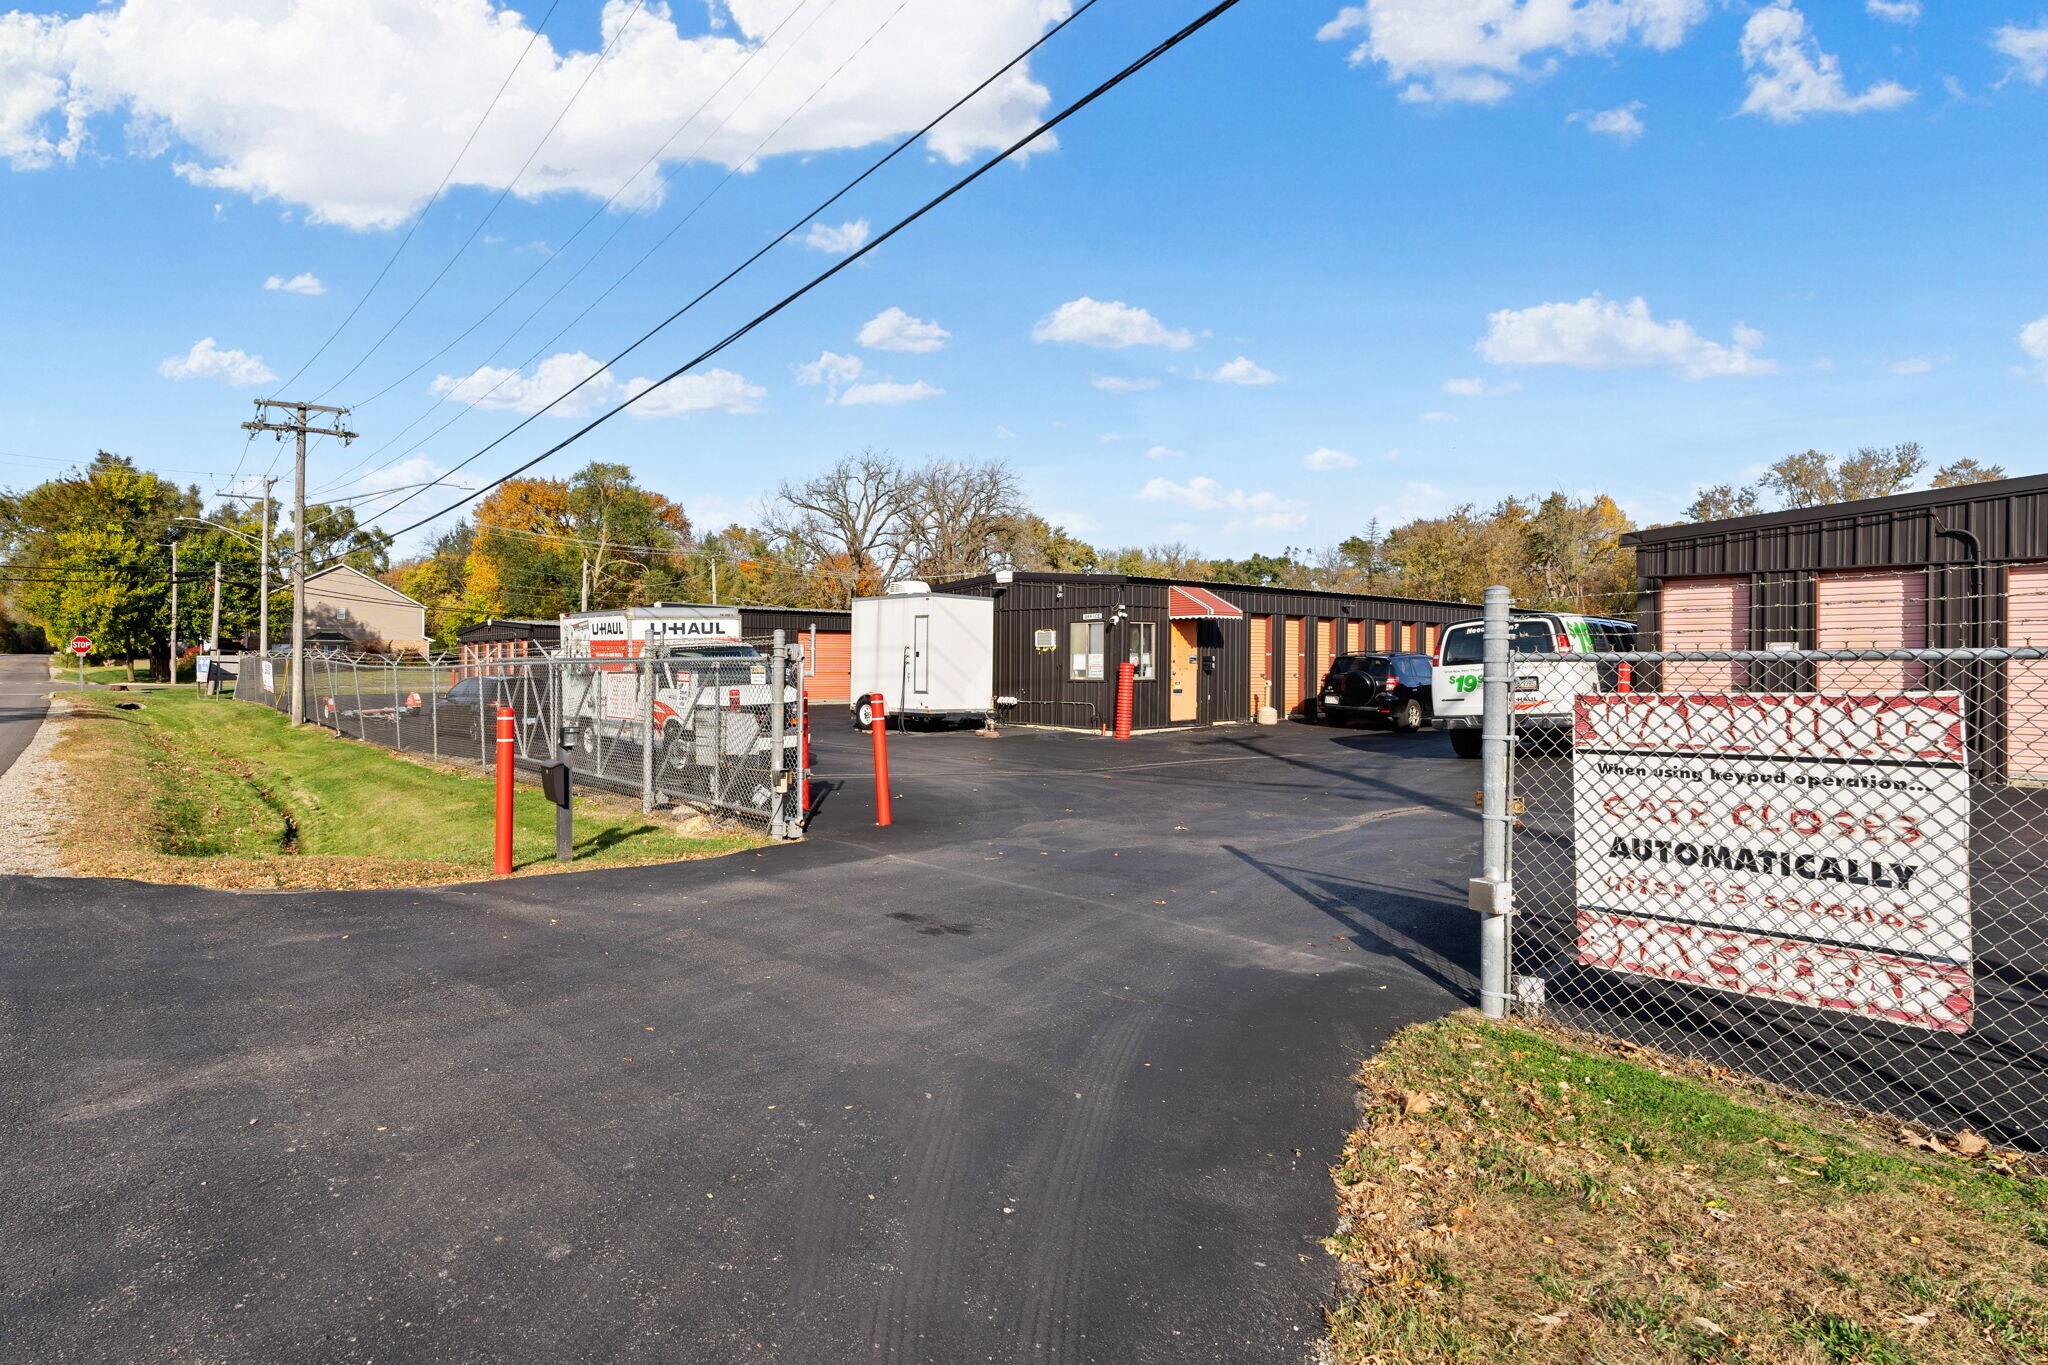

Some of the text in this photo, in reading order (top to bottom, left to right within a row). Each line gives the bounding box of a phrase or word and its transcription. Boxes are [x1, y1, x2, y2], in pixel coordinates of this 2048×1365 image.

[592, 622, 624, 635] U-HAUL
[650, 622, 726, 635] U-HAUL
[1466, 624, 1484, 636] Nee
[1597, 763, 1647, 777] When
[1653, 766, 1703, 782] using
[1710, 768, 1787, 786] keypad
[1732, 803, 1923, 843] CLOSES
[1608, 837, 1920, 891] AUTOMATICALLY
